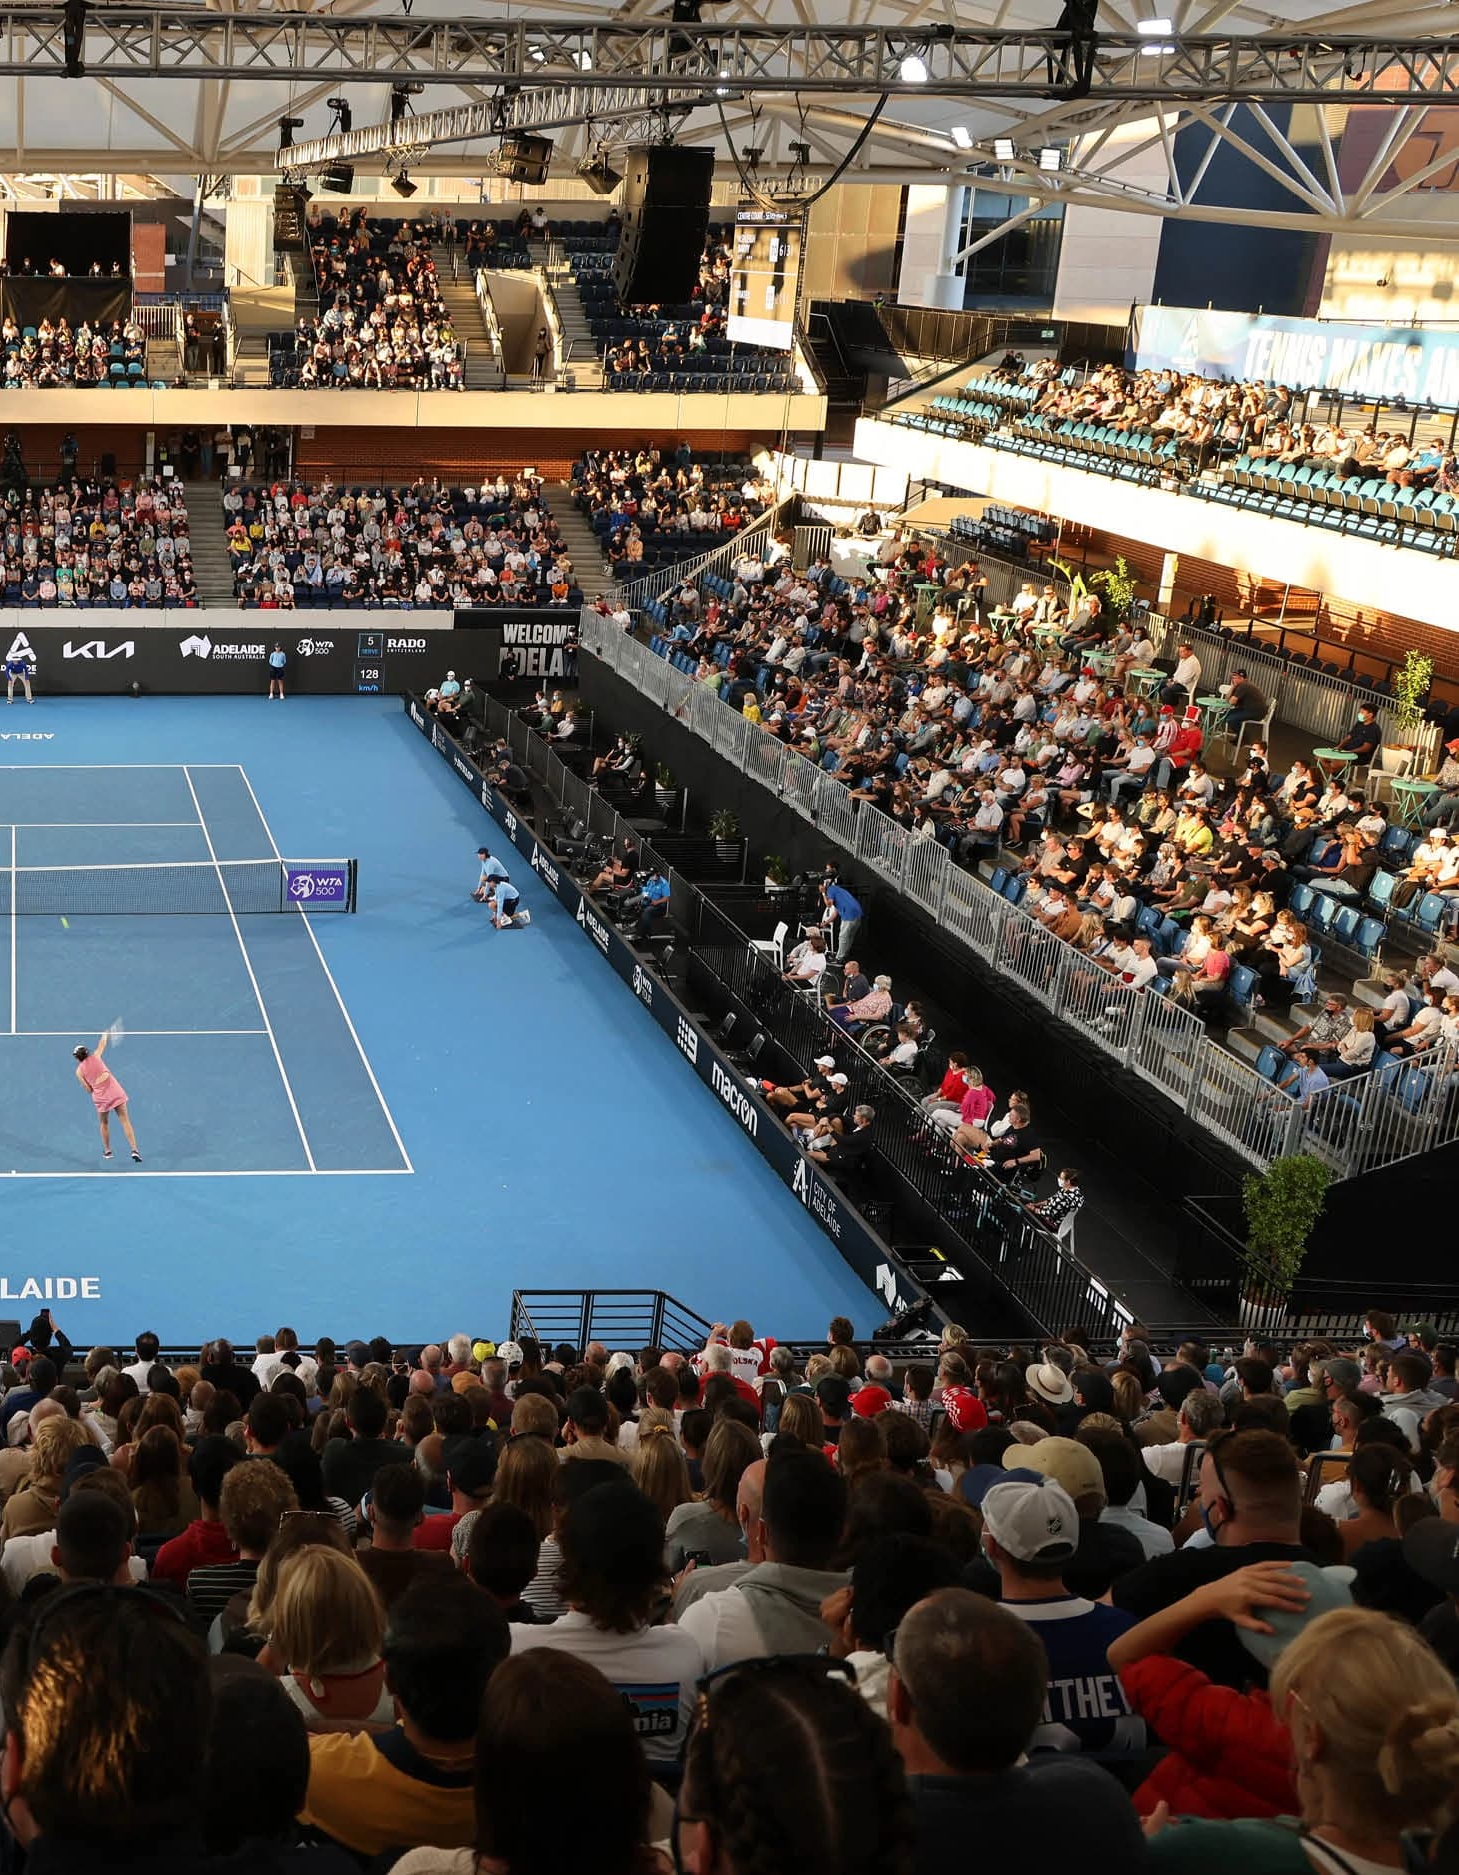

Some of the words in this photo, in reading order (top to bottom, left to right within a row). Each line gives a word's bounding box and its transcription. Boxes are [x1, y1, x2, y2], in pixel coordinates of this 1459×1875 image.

[1243, 329, 1327, 387] TENNIS
[503, 623, 575, 645] WELCOM
[315, 640, 335, 648] WTA
[367, 636, 374, 646] 5
[387, 638, 426, 648] RADO
[63, 640, 135, 659] KIA
[213, 644, 266, 654] ADELAIDE
[315, 647, 330, 655] 500
[360, 669, 379, 679] 128
[358, 684, 379, 692] km/h
[539, 855, 559, 885] ADELAIDE
[316, 877, 342, 886] WTA
[315, 887, 335, 896] 500
[586, 910, 610, 947] ADELAIDE
[711, 1060, 758, 1137] macron
[814, 1181, 828, 1204] CITY
[827, 1199, 837, 1214] OF
[812, 1199, 841, 1238] ADELAIDE
[732, 1356, 758, 1368] OLSKA
